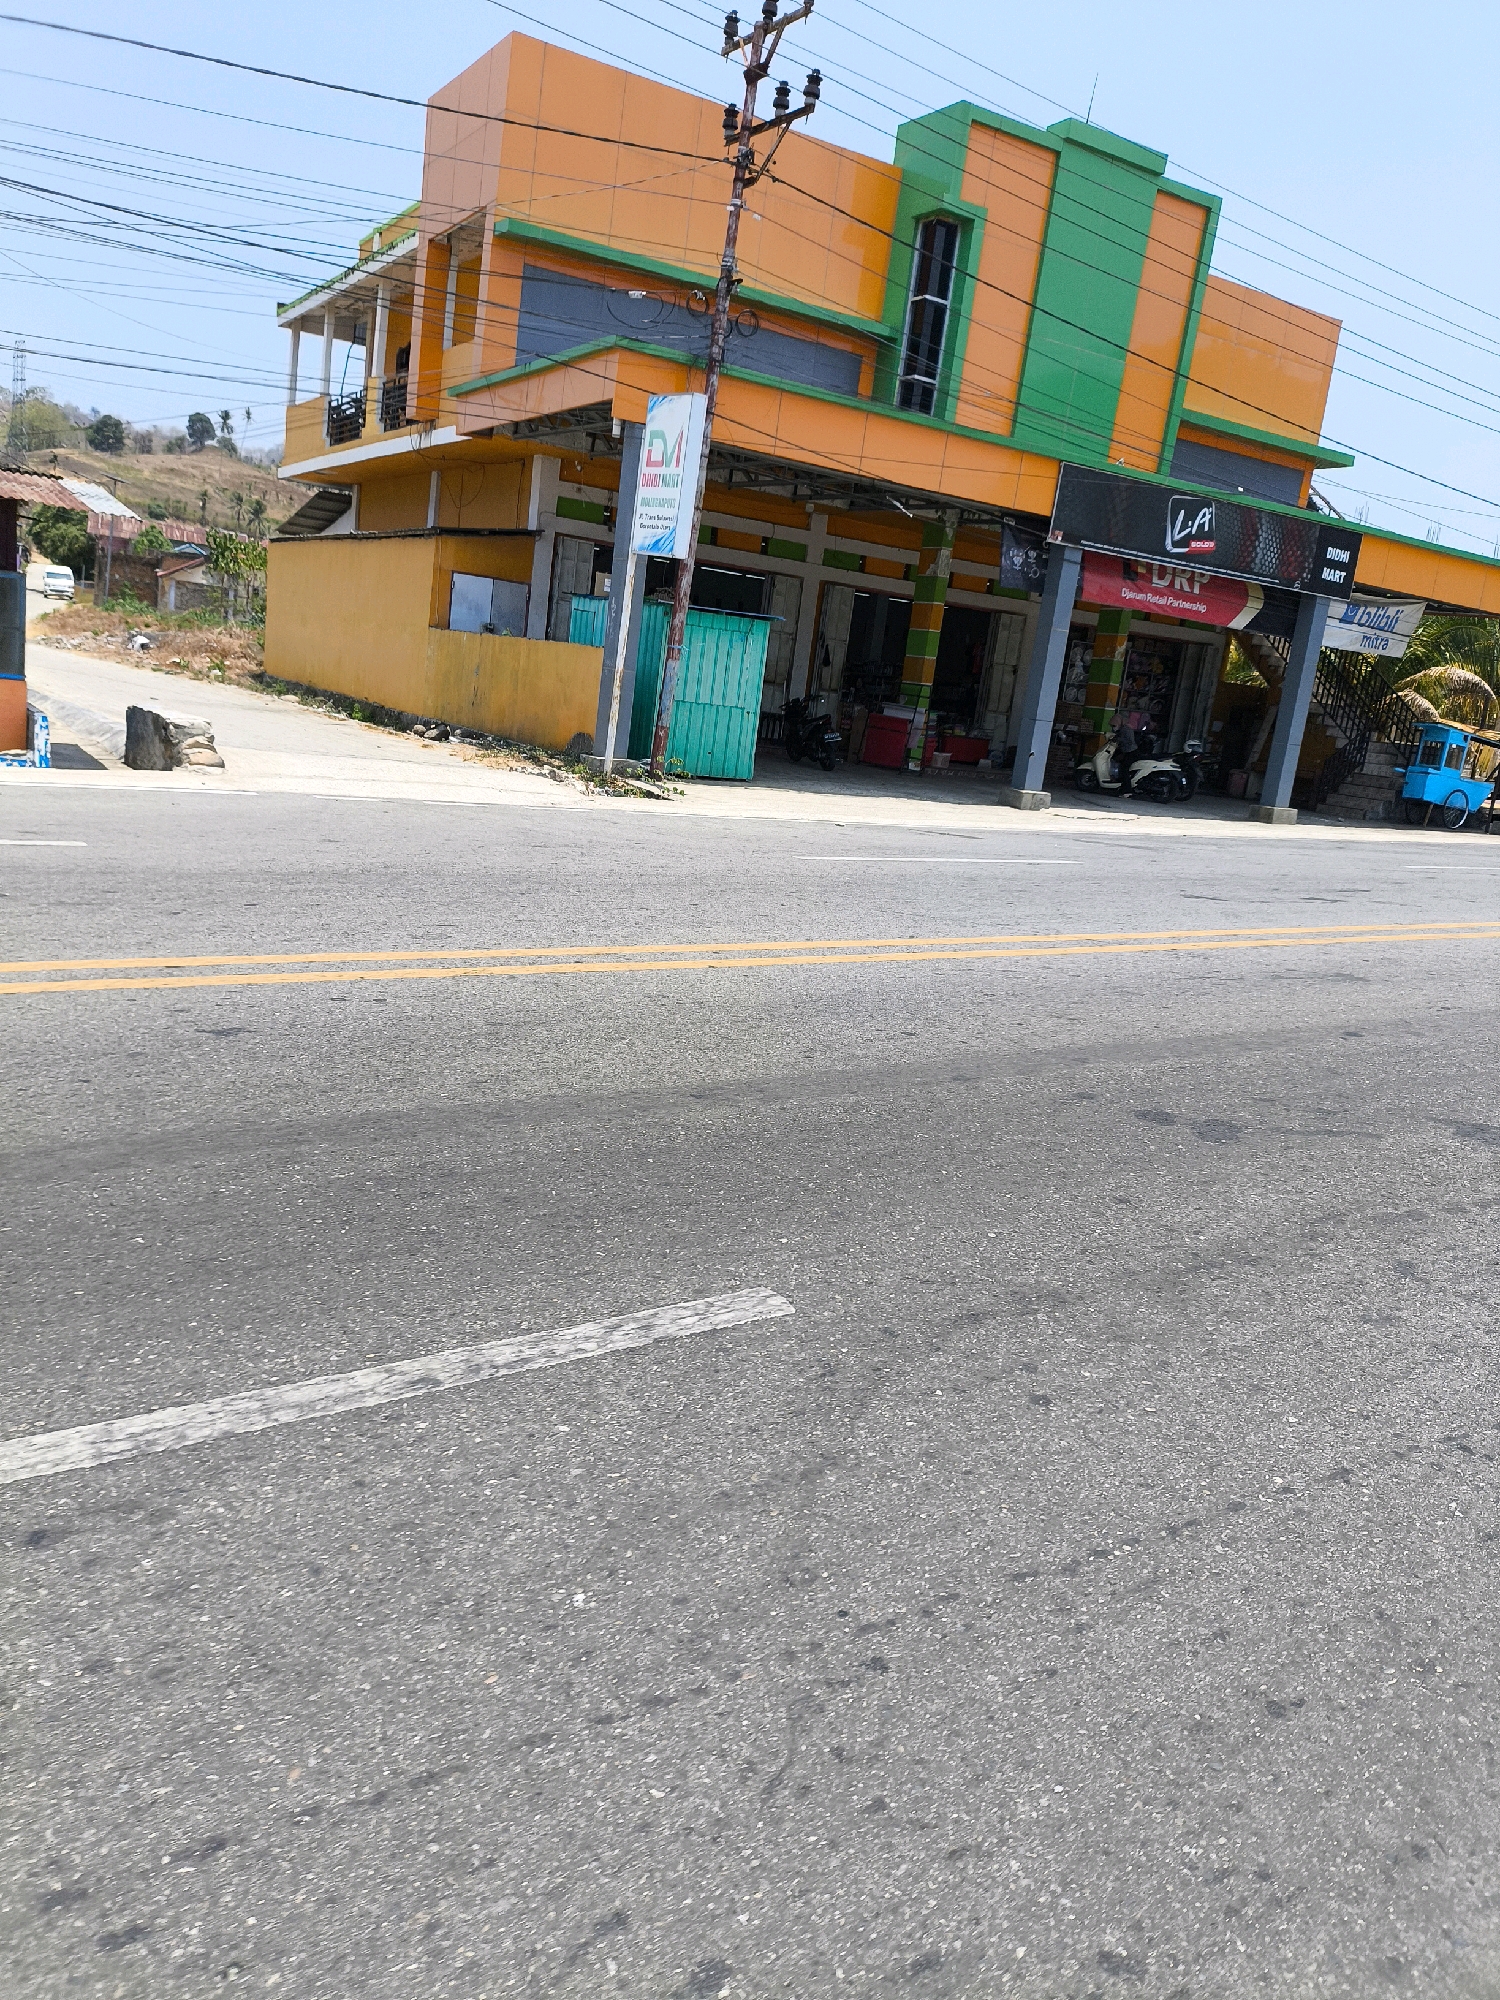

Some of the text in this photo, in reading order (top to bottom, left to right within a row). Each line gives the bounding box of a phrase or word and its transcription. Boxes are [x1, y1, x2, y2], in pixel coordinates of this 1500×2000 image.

[1326, 546, 1351, 563] DIDHI
[1321, 567, 1347, 584] MART
[1121, 588, 1207, 613] Djarum Retail Partnership
[1357, 604, 1404, 632] blibli
[1359, 632, 1390, 651] mitra
